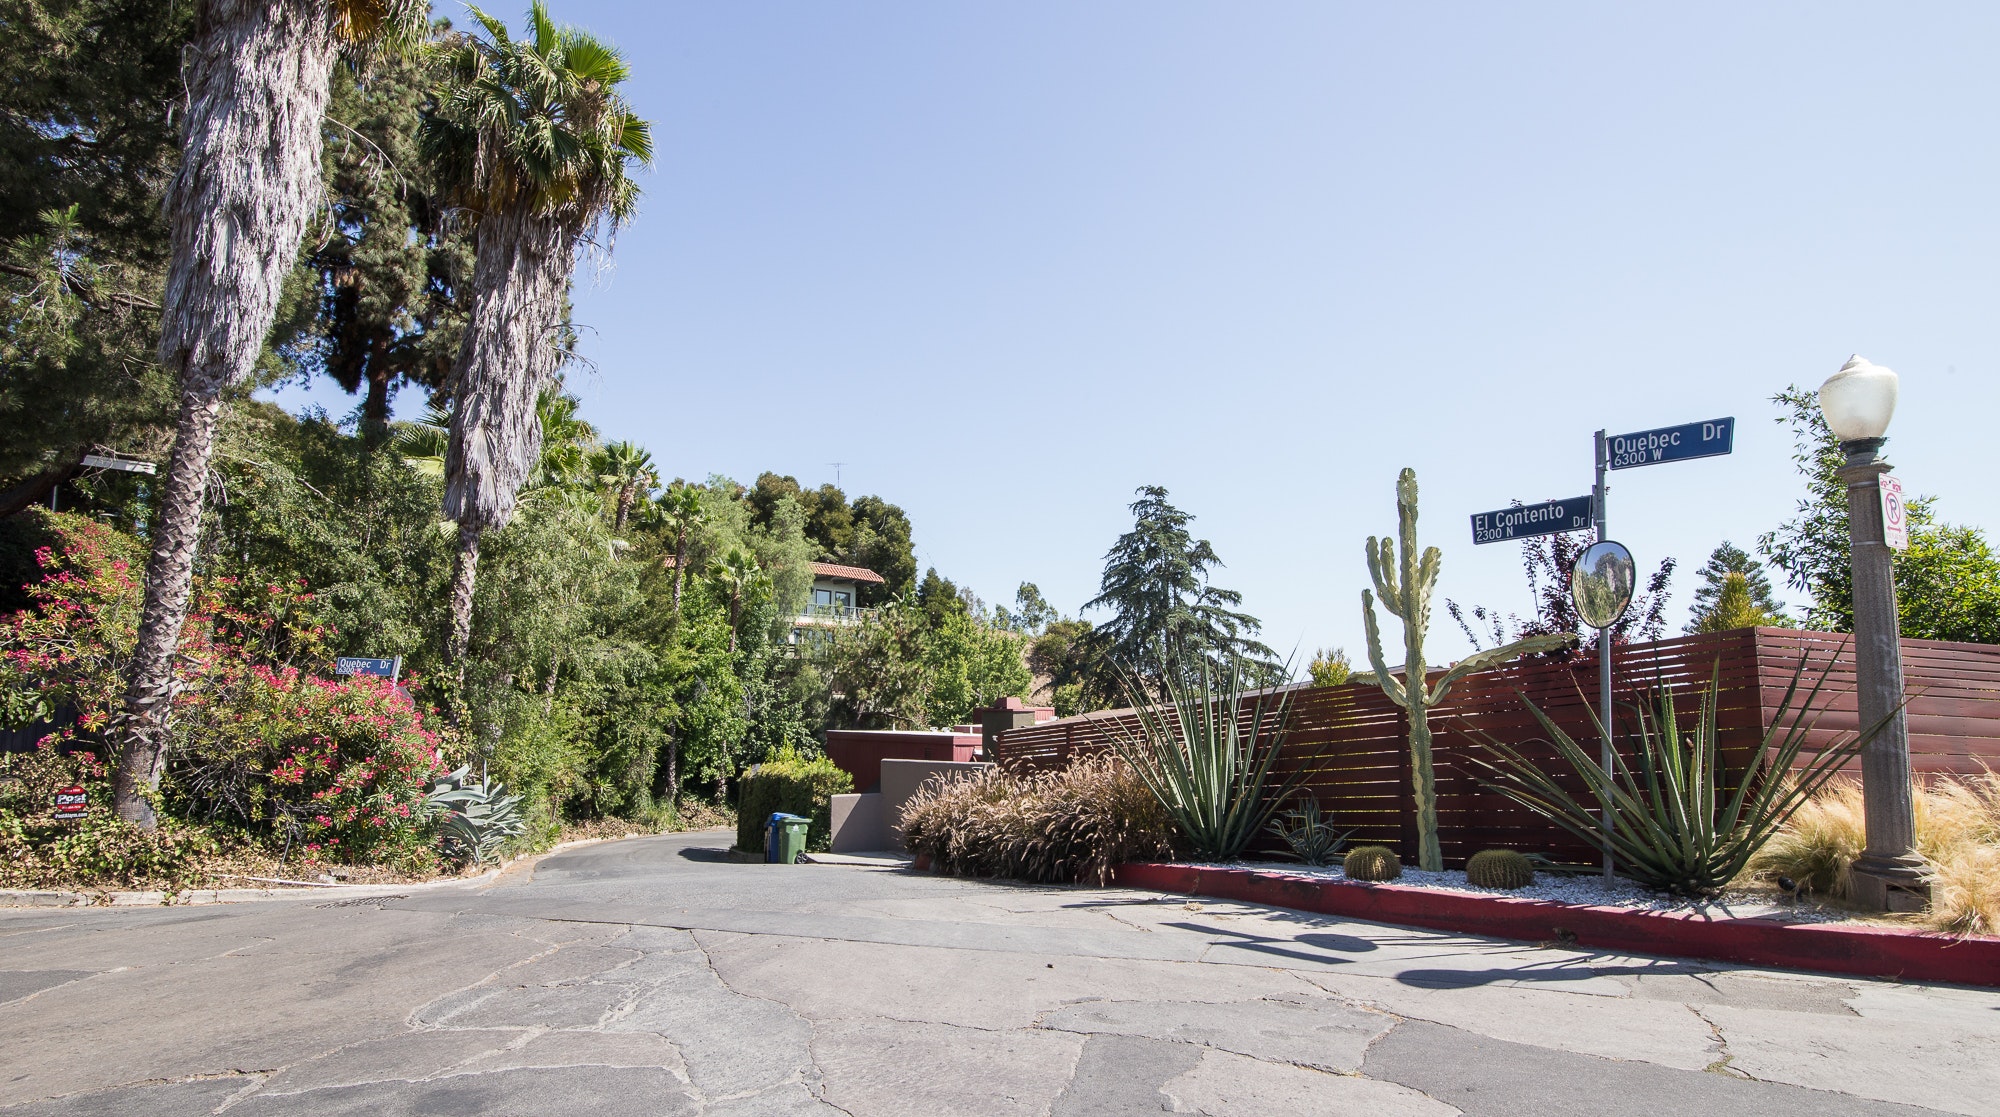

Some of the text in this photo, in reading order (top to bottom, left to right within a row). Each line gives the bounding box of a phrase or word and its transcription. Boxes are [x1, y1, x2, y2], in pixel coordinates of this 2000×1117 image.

[1614, 423, 1725, 455] Quebec Dr
[1614, 448, 1663, 466] 6300 W
[1476, 504, 1586, 531] El Contento Dr
[1476, 526, 1514, 542] 2300 N
[340, 658, 391, 669] Quebec Dr
[57, 793, 87, 802] Post
